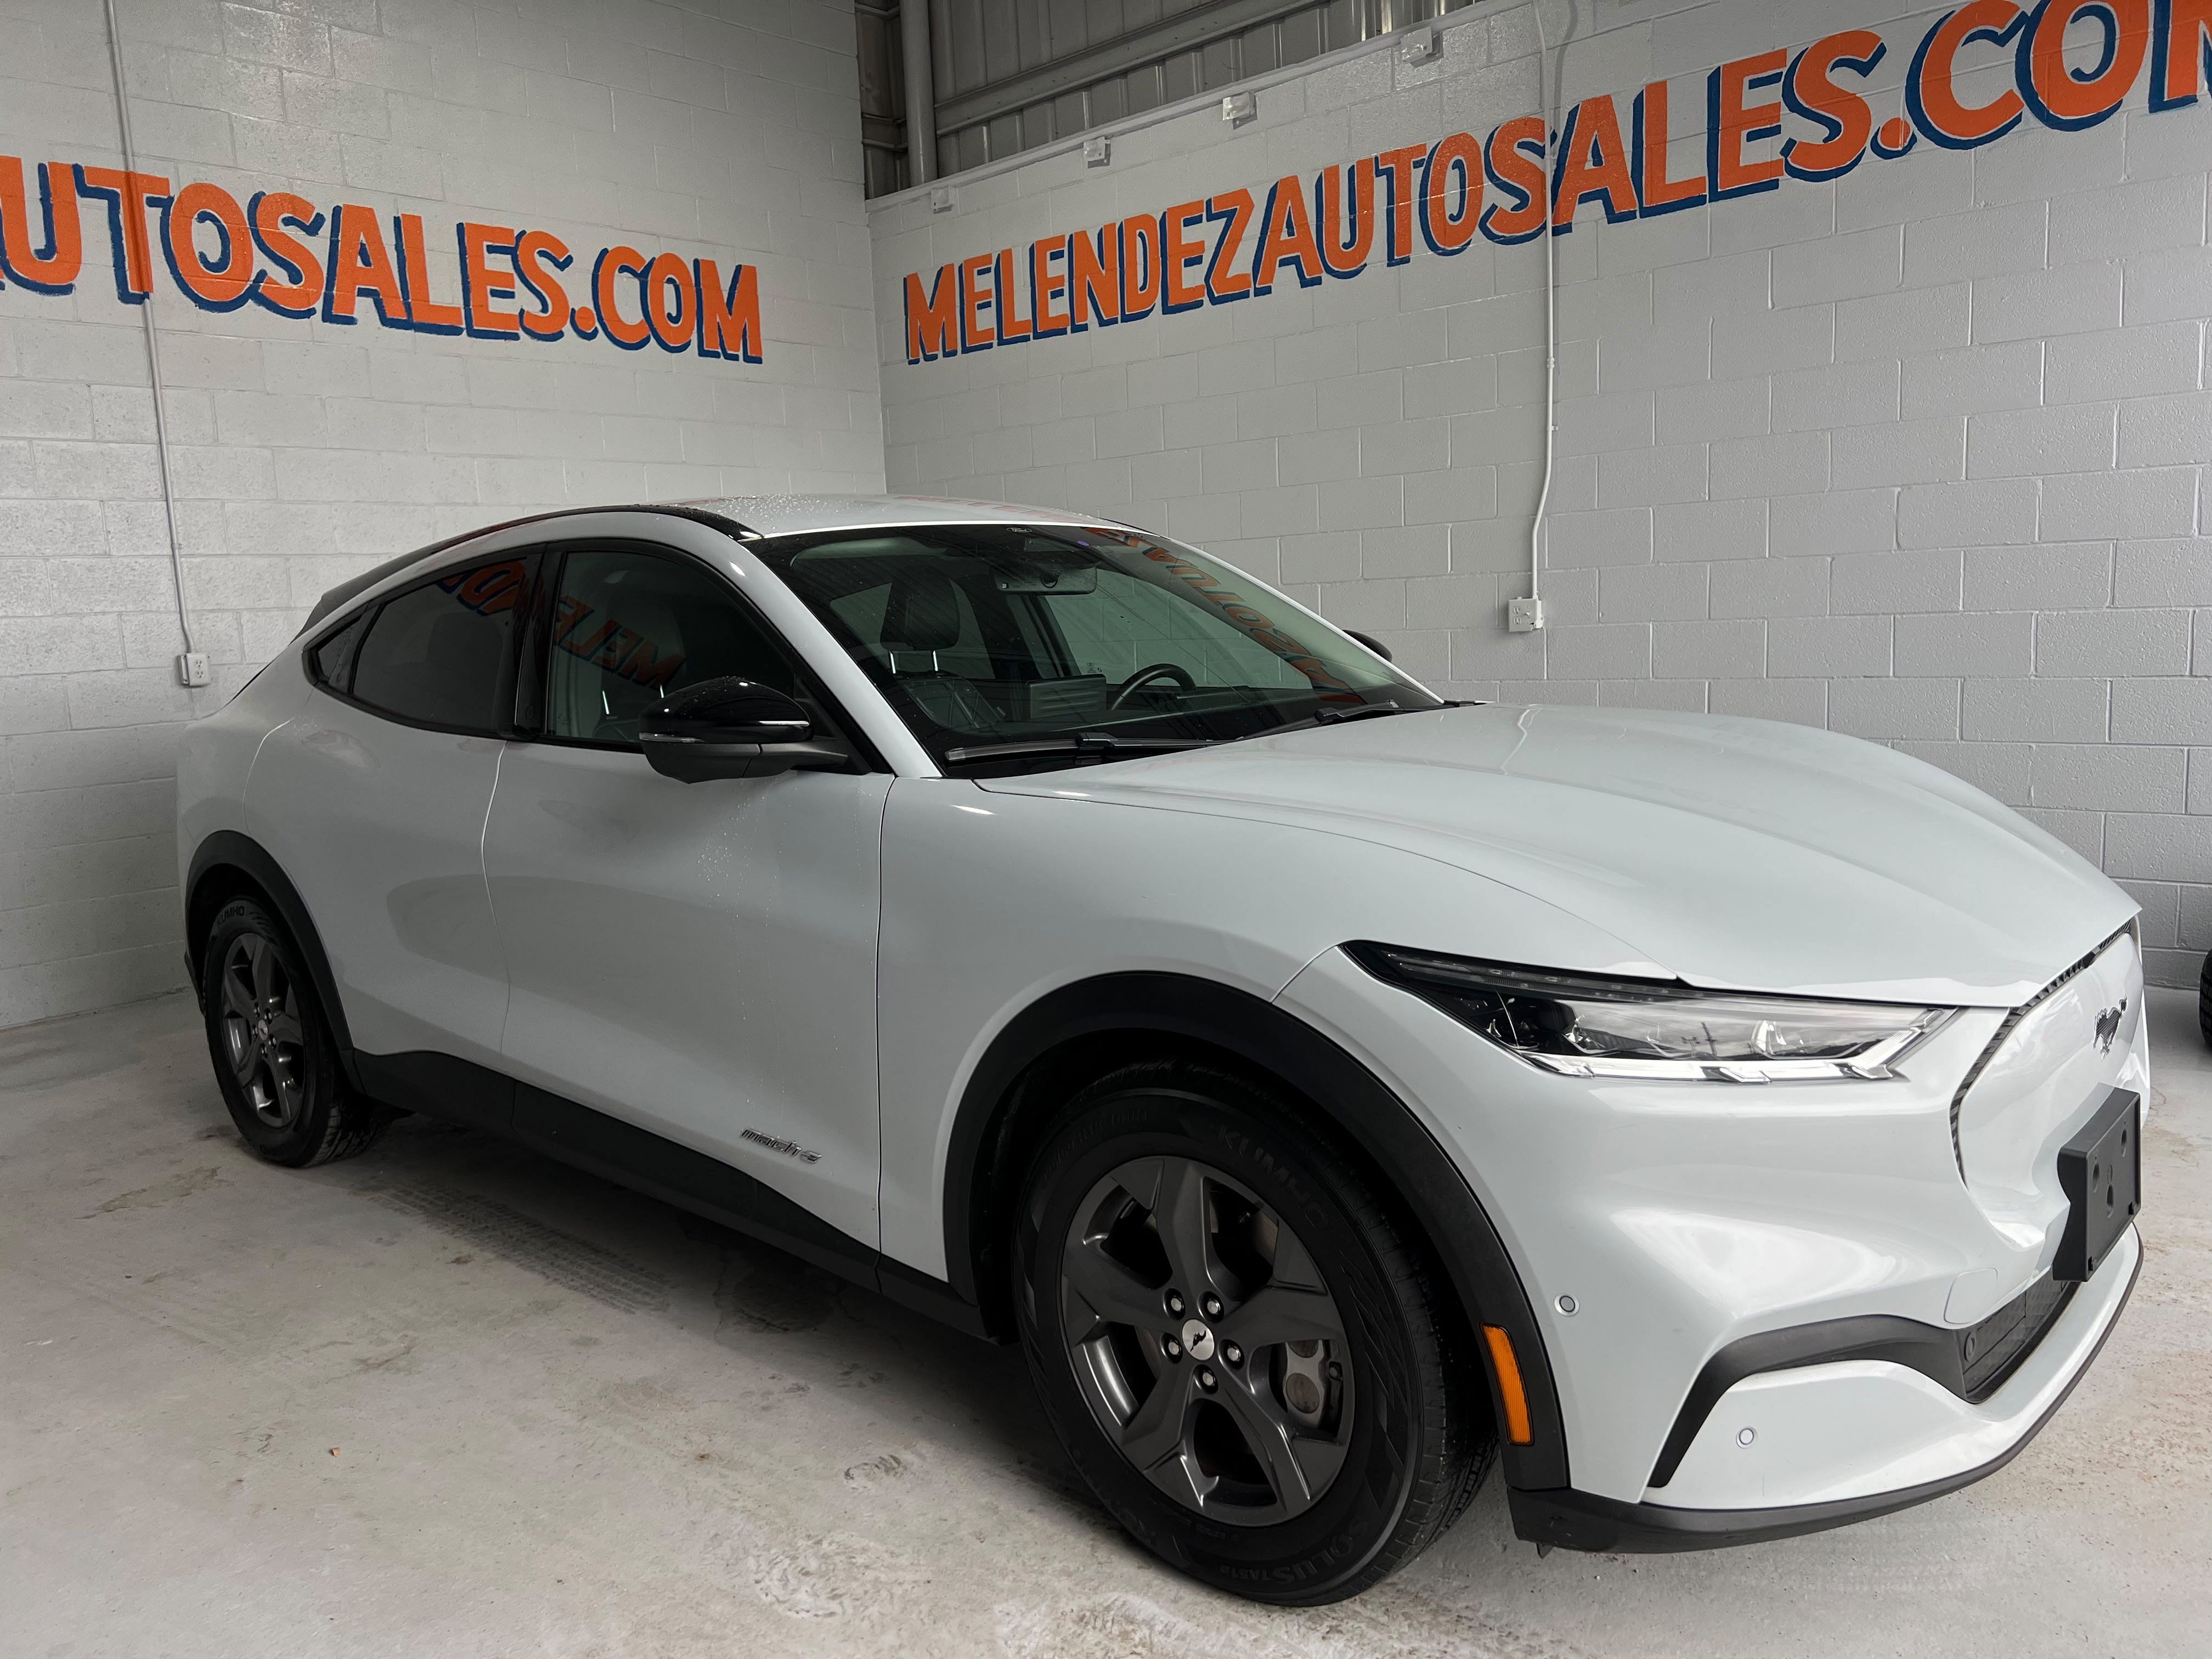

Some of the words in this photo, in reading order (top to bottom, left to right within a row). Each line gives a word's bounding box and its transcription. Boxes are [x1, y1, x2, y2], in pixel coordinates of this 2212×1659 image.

[0, 155, 763, 364] UTOSALES.COM
[216, 906, 245, 929] KUMHO
[1217, 1123, 1327, 1228] KUMHO
